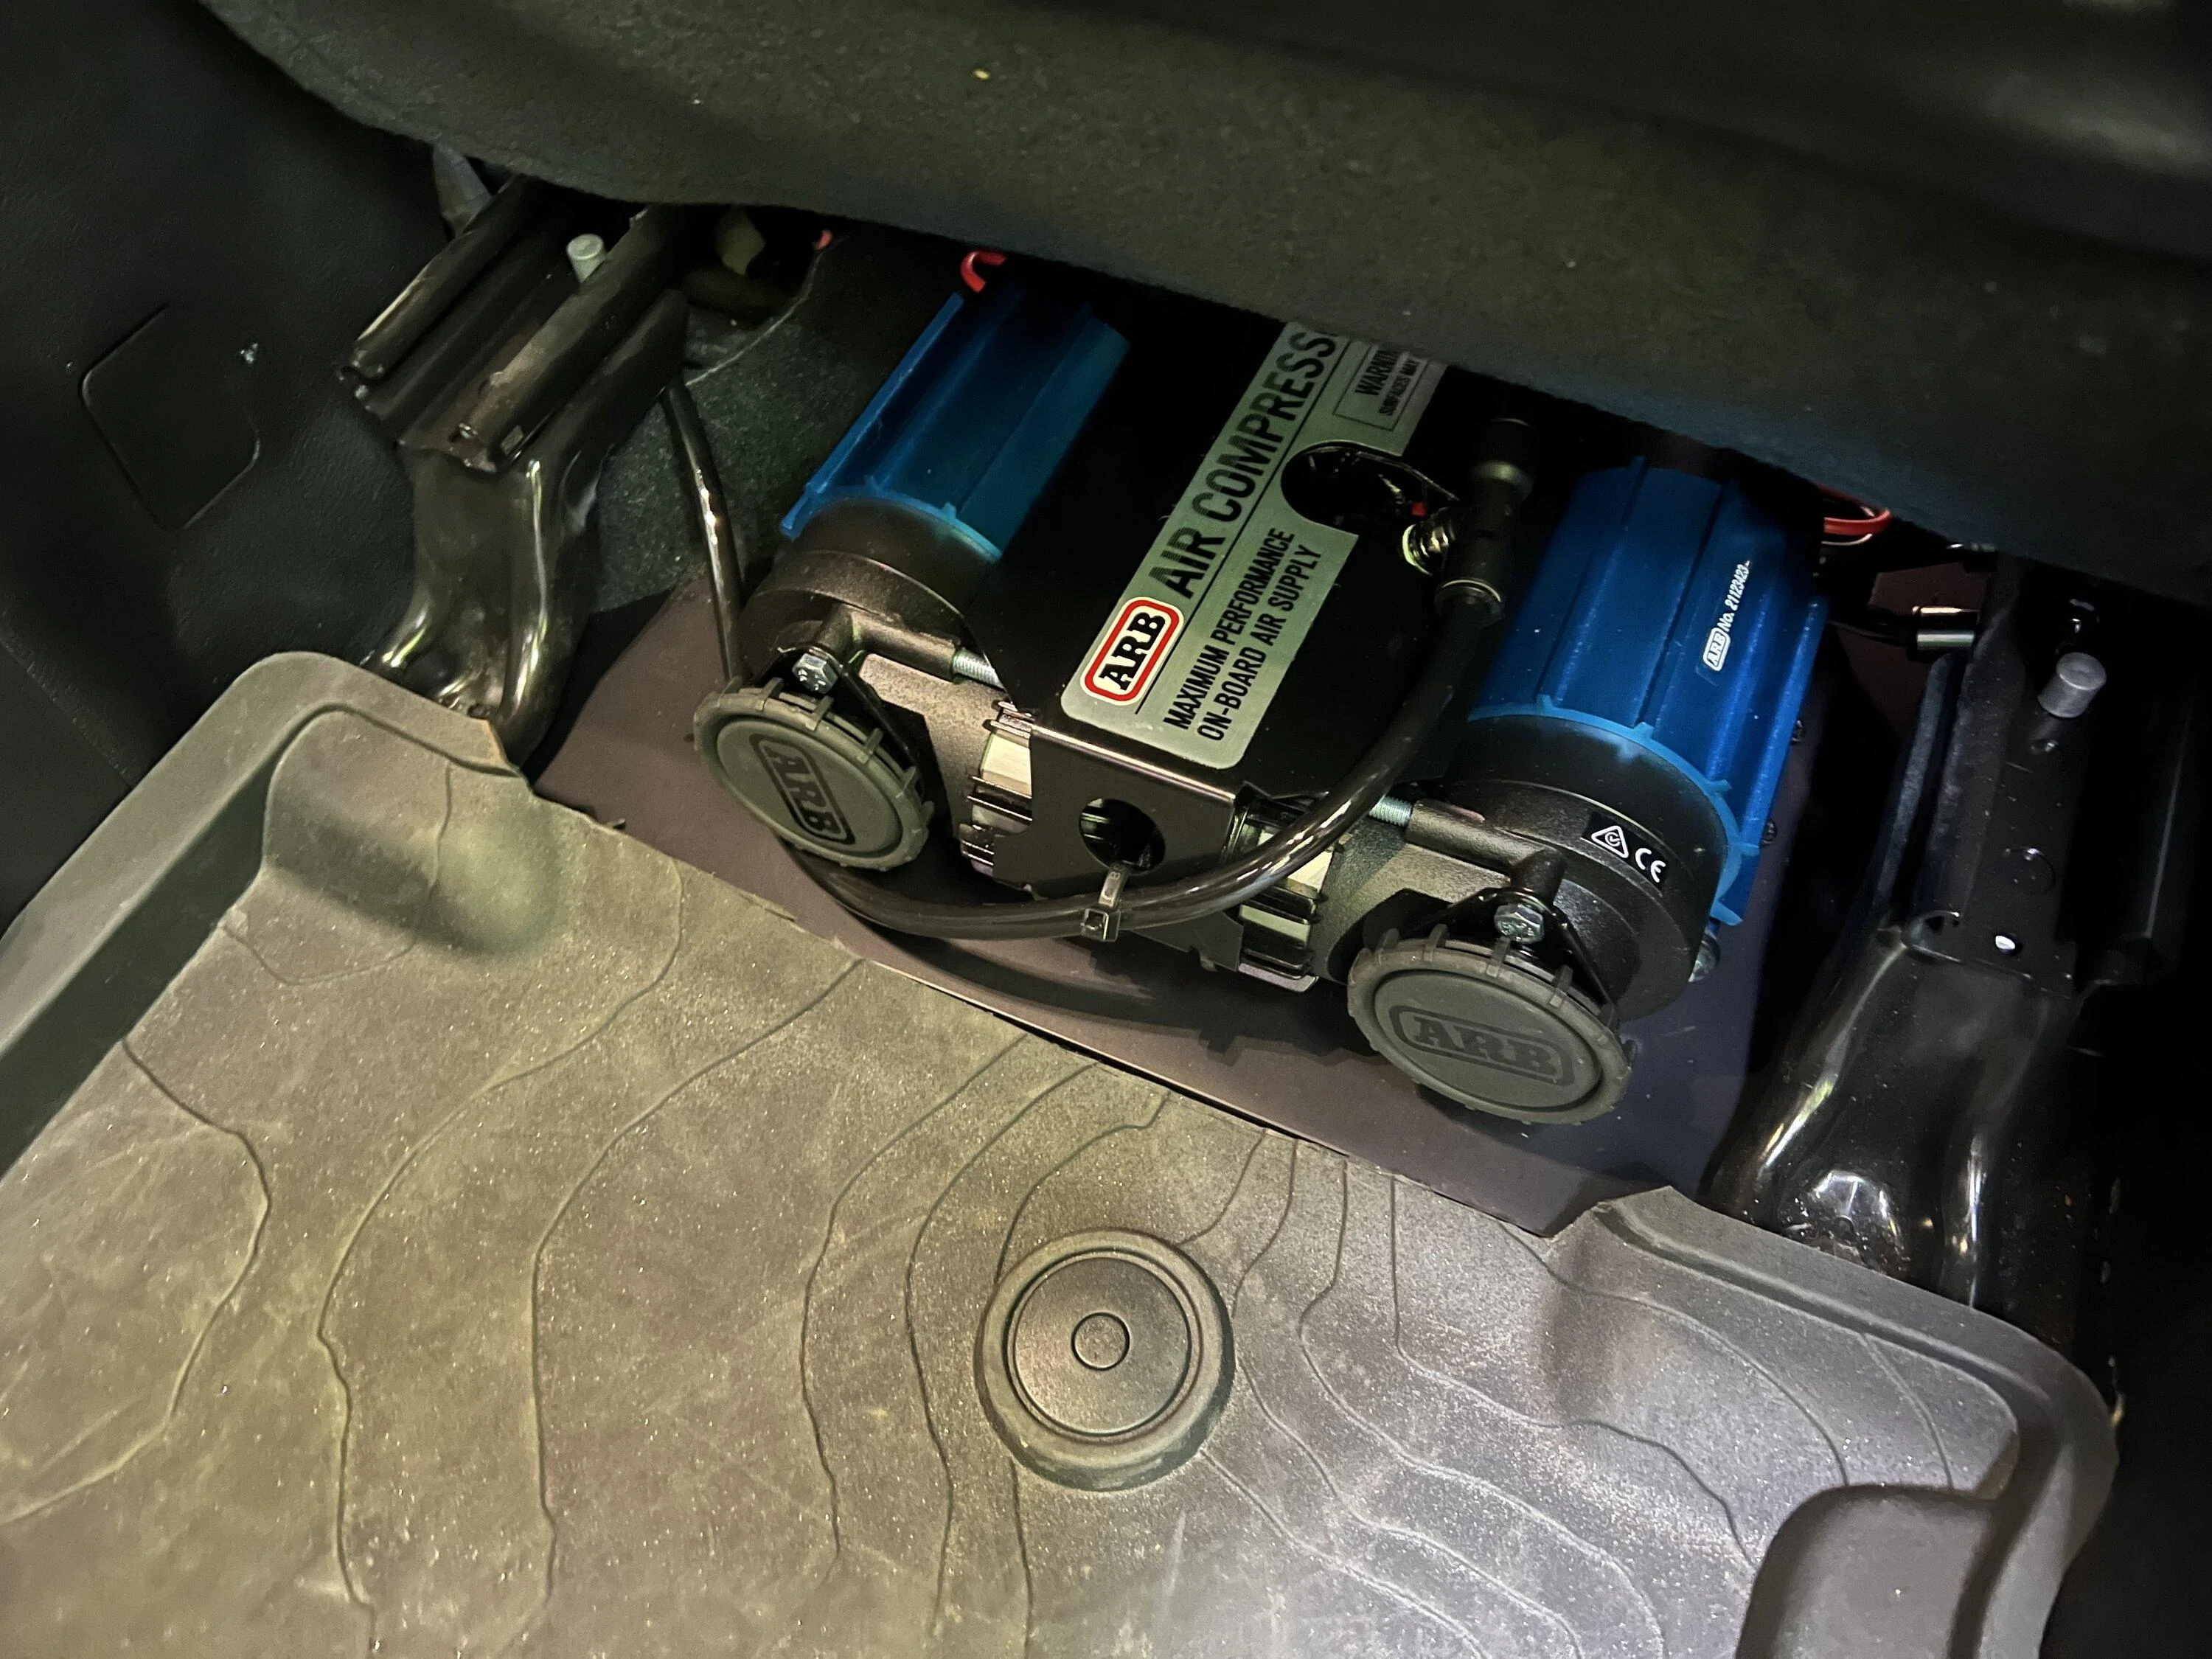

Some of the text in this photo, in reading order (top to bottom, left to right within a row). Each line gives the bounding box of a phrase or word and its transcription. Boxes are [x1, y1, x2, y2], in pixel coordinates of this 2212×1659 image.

[1098, 332, 1336, 692] ARB AIR COMPRESS
[1163, 527, 1295, 730] MAXIMUM PERFORMANCE
[1197, 543, 1322, 742] ON-BOARD AIR SUPPLY
[1717, 612, 1735, 633] No.
[763, 746, 842, 834] ARB
[1413, 1015, 1559, 1077] ARB
